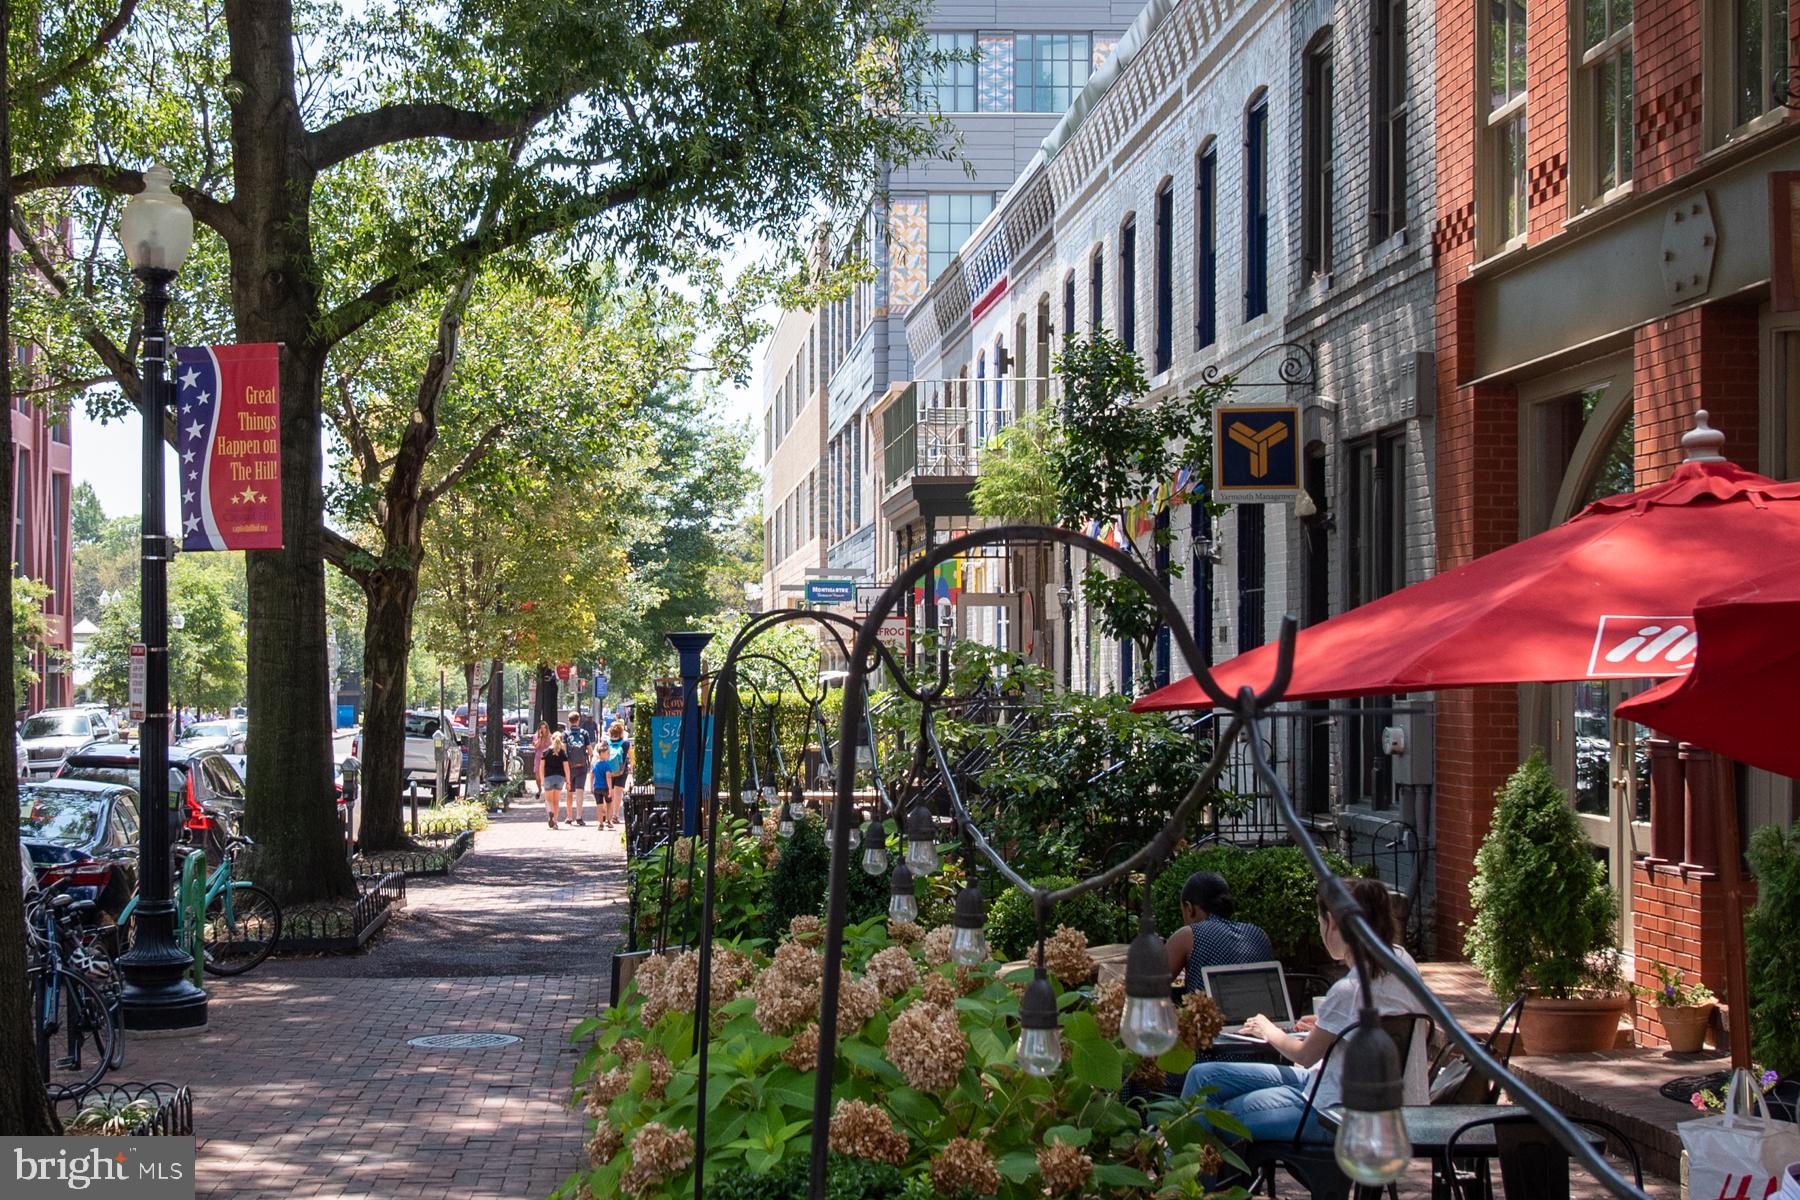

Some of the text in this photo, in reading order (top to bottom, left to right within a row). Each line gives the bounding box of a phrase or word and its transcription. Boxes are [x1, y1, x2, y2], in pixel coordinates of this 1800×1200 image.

[245, 385, 276, 405] Great
[237, 411, 277, 434] Things
[217, 435, 277, 458] Happen on
[230, 460, 278, 481] The Hill!
[1604, 625, 1698, 669] ill
